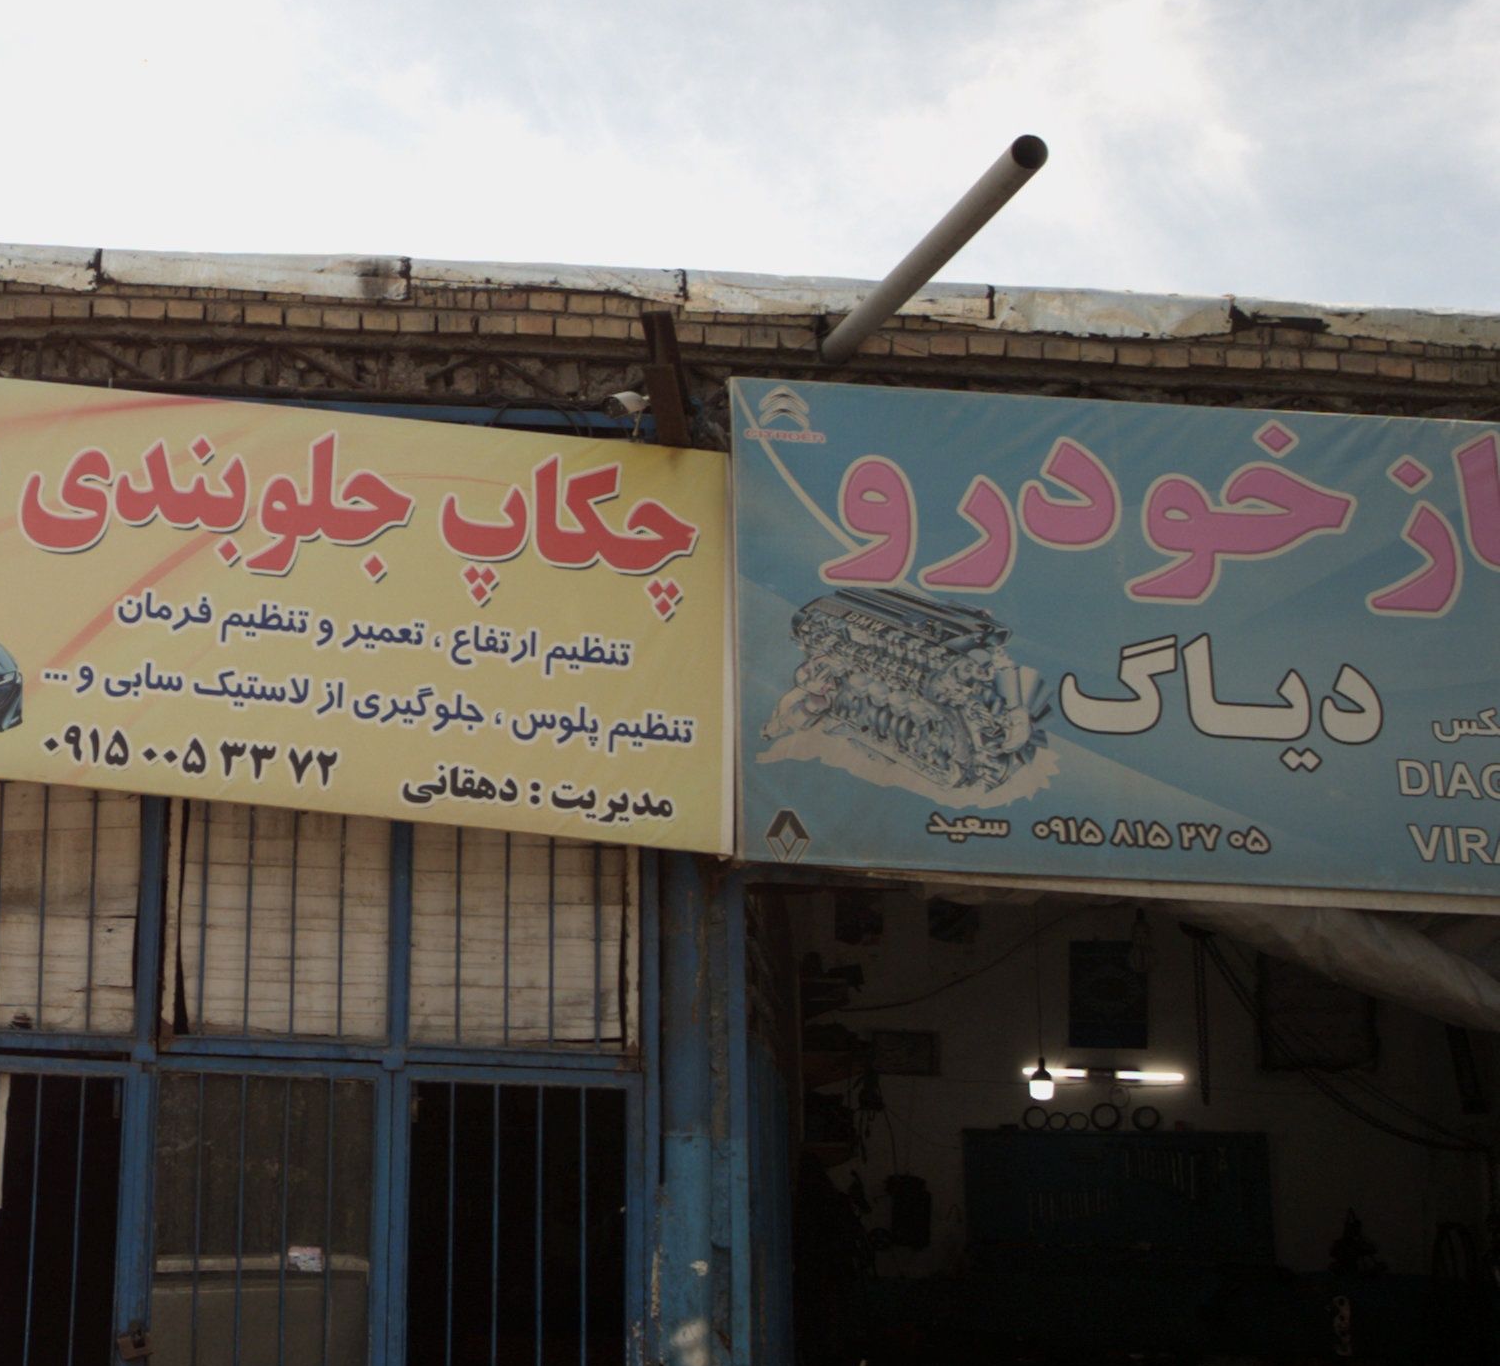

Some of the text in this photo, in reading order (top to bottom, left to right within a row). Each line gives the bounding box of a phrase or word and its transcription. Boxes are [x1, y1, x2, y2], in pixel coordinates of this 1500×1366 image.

[20, 431, 415, 580] جلوبندی
[819, 420, 1500, 617] از خودرو
[440, 454, 699, 621] چکاپ
[118, 592, 212, 630] فرمان
[221, 604, 309, 642] تنظیم
[845, 611, 887, 633] BMW
[317, 619, 333, 646] و
[343, 621, 424, 649] تعمیر
[451, 626, 536, 665] ارتفاع
[545, 635, 631, 675] تنظیم
[76, 666, 94, 692] و
[105, 663, 183, 696] سابی
[193, 671, 310, 706] لاستیک
[317, 682, 343, 714] از
[353, 688, 484, 731] جلوگیری
[1059, 633, 1383, 771] دیاگ
[512, 707, 598, 746] پلوس
[609, 713, 693, 752] تنظیم
[1432, 707, 1500, 743] کس
[44, 725, 338, 785] ۰۹۱۵ ۰۰۵ ۳۳ ۷۲
[403, 765, 518, 803] دهقانی
[551, 784, 673, 823] مدیریت
[926, 812, 1010, 843] سعید
[1032, 815, 1105, 845] ۰۹۱۵
[1111, 820, 1172, 849] ۸۱۵
[1228, 825, 1271, 855] ۰۵
[1407, 824, 1500, 865] VIR
